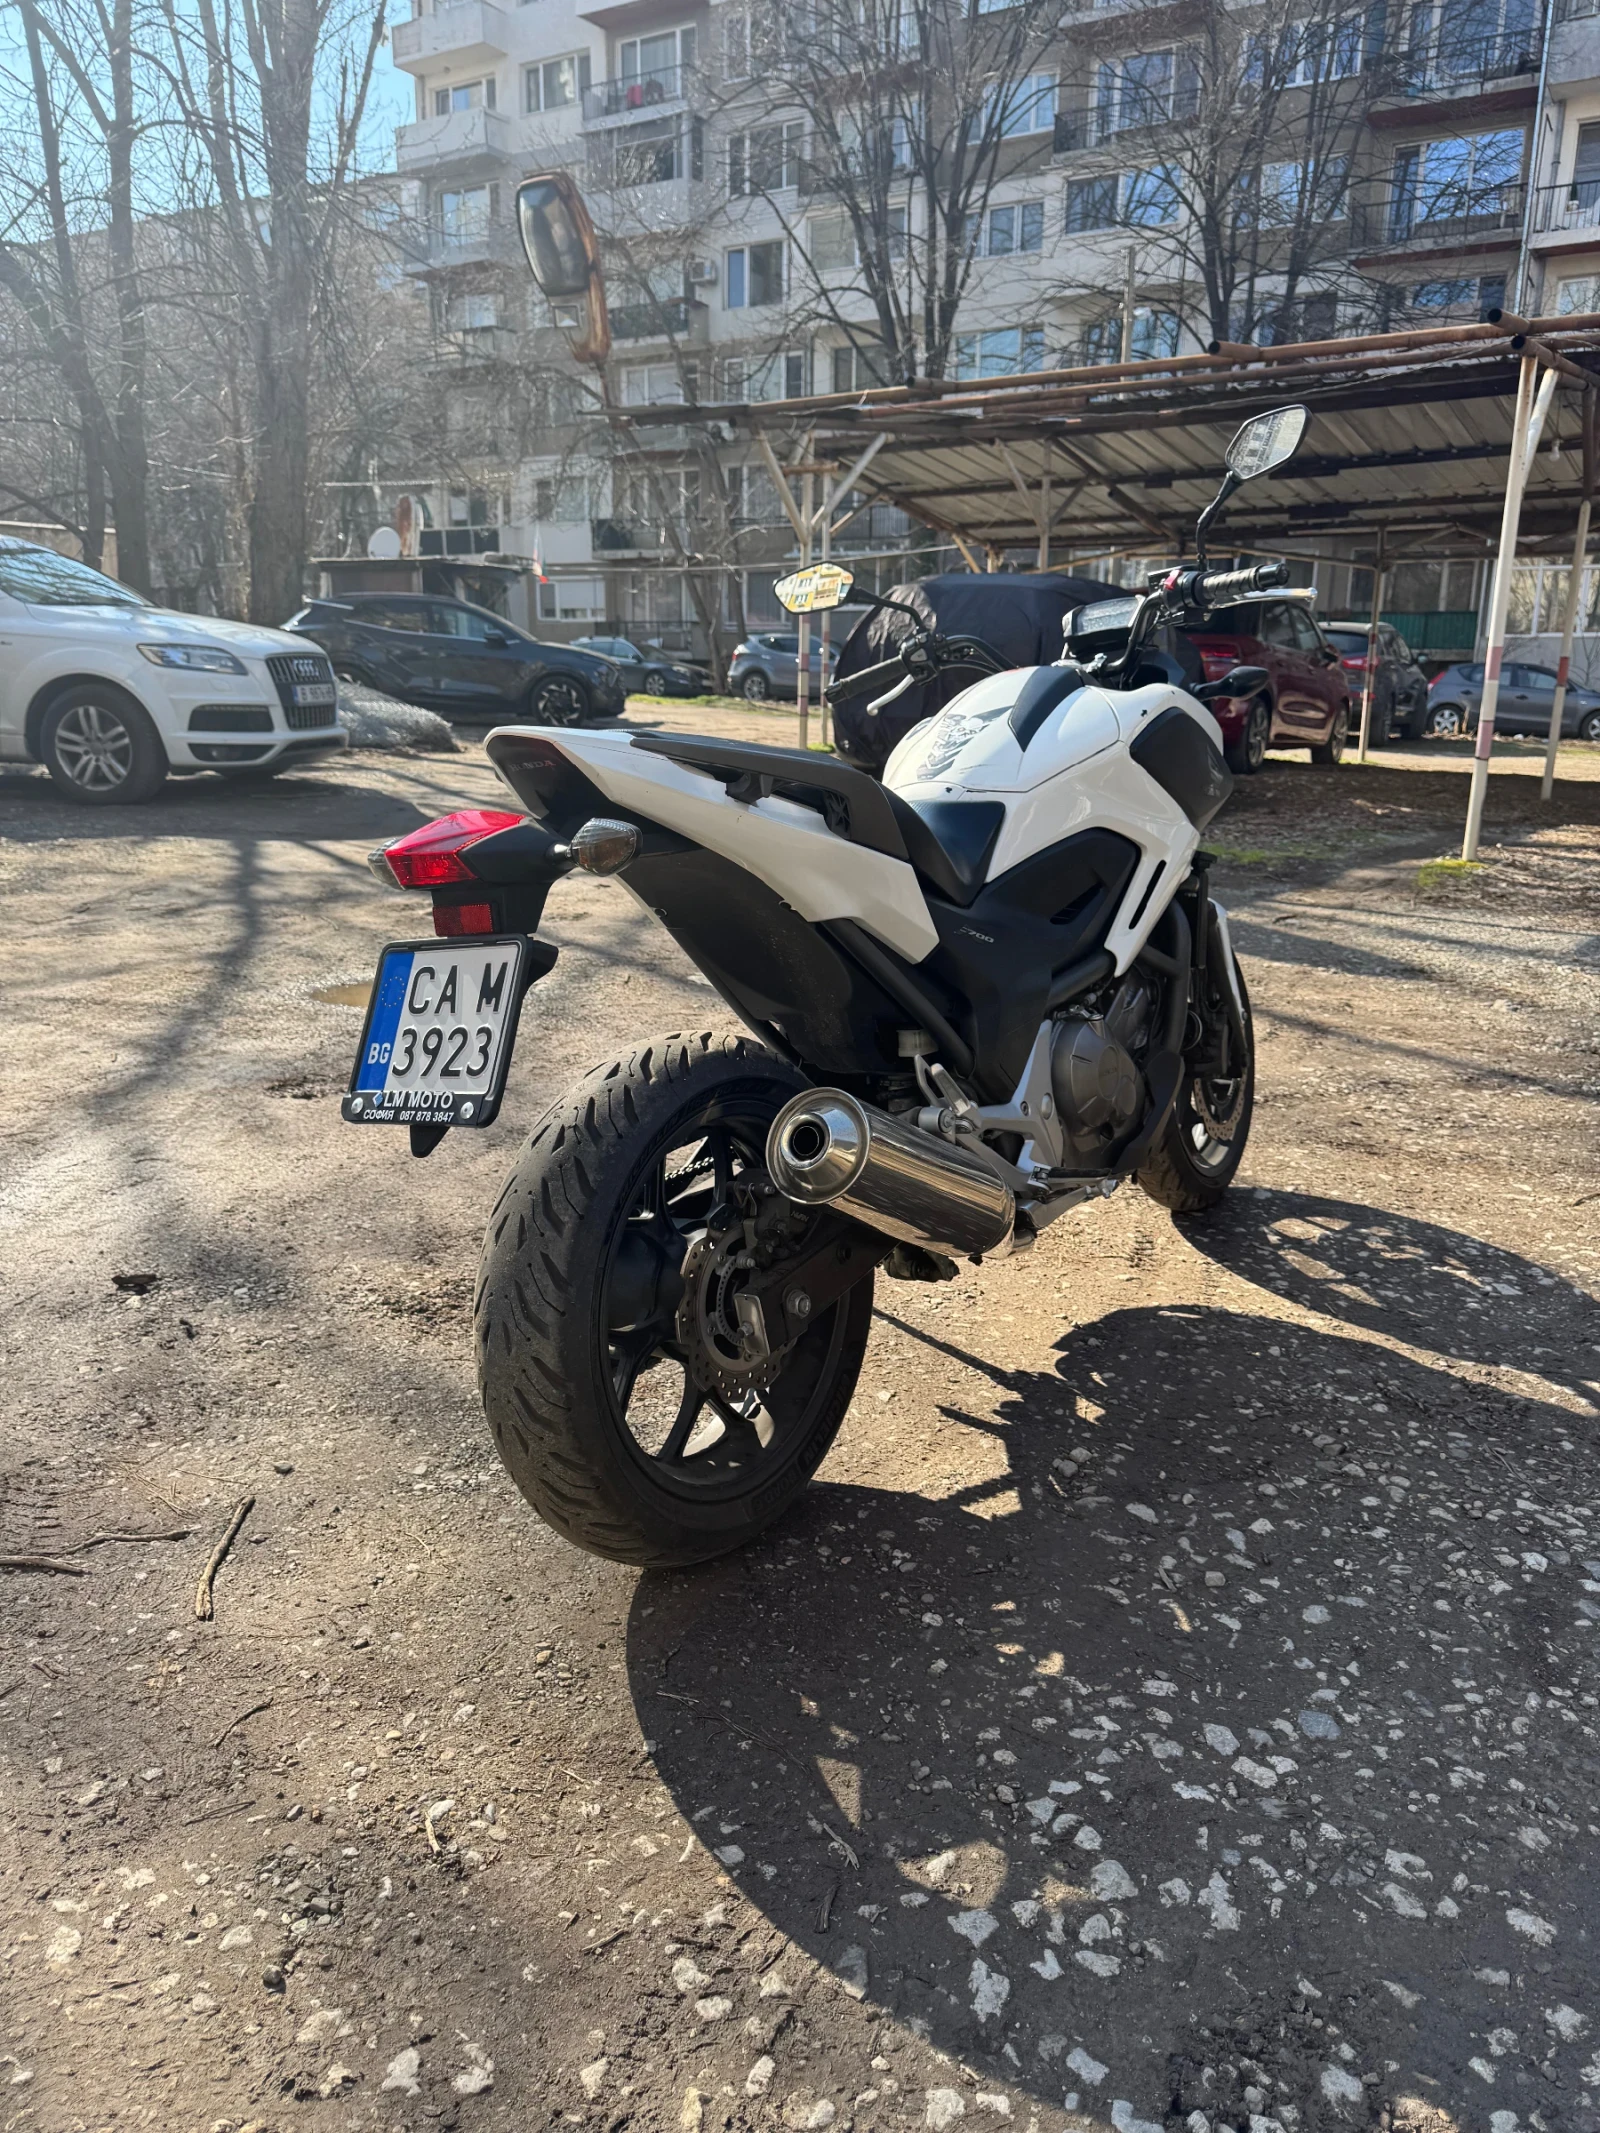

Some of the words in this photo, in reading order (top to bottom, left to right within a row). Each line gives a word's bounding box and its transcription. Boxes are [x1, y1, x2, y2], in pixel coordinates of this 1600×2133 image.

[509, 760, 557, 772] HONDA
[408, 965, 459, 1015] CA
[476, 962, 508, 1014] M
[367, 1043, 391, 1064] BG
[391, 1025, 493, 1078] 3923
[383, 1091, 404, 1108] LM
[407, 1091, 453, 1109] MOTO
[363, 1109, 394, 1120] СОФИЯ
[400, 1110, 415, 1121] 087
[416, 1111, 431, 1122] 878
[433, 1112, 454, 1122] 3847
